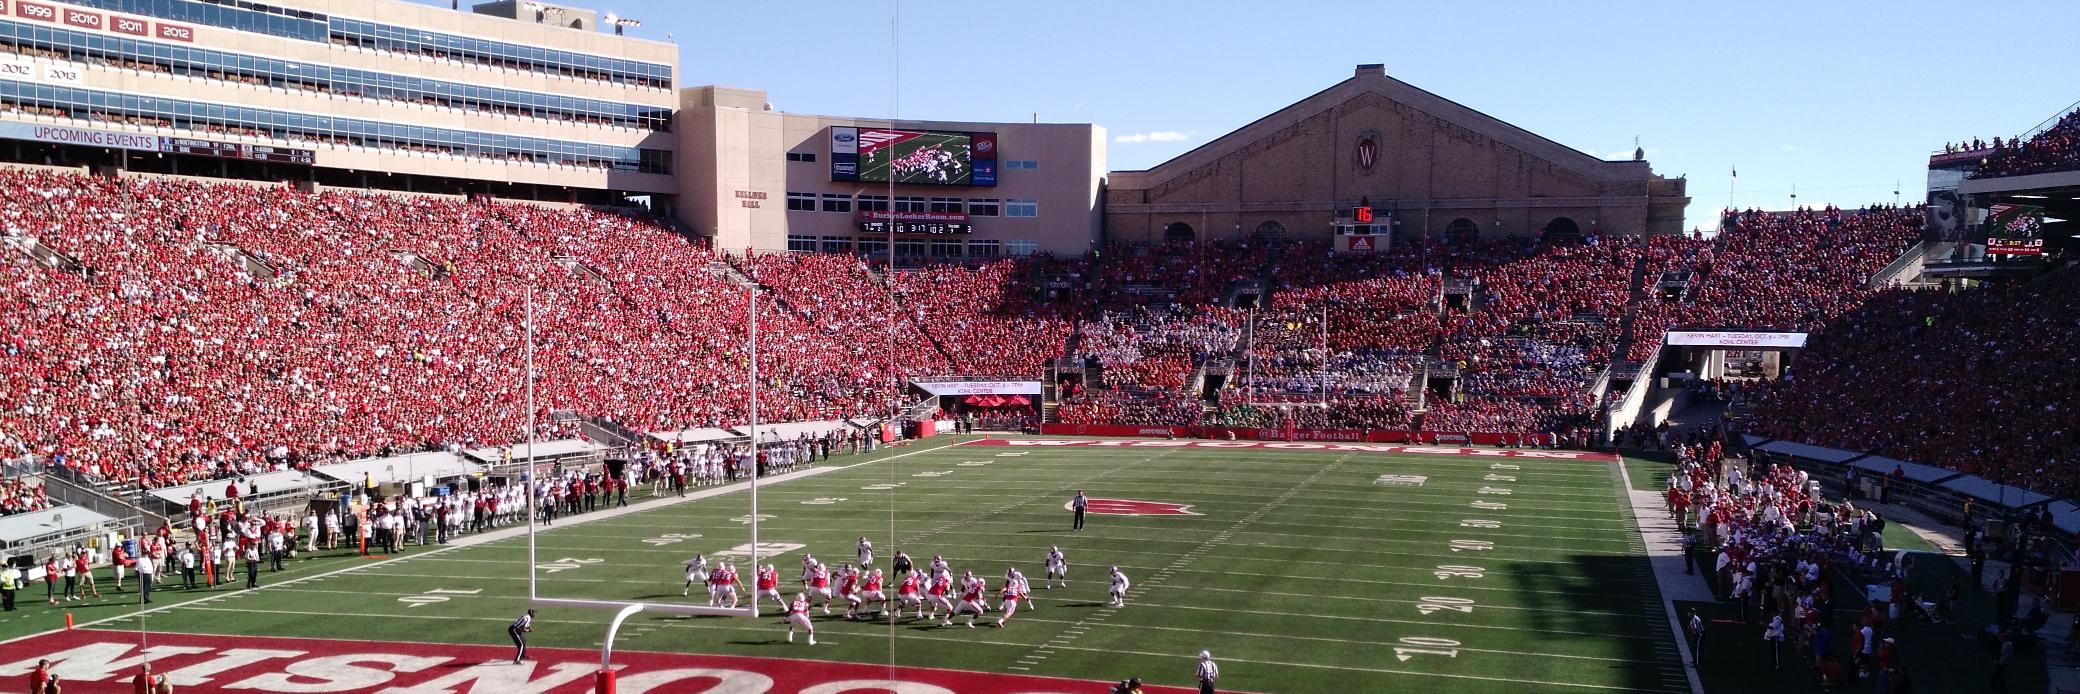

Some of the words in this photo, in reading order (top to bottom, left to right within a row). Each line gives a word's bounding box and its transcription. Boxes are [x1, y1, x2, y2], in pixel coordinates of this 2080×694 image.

[23, 5, 52, 18] 1999
[70, 12, 99, 25] 2010
[119, 20, 142, 32] 2011
[164, 27, 189, 38] 2012
[2, 64, 30, 75] 2012
[50, 70, 77, 80] 2013
[34, 126, 102, 144] UPCOMING
[106, 133, 152, 148] EVENTS
[1360, 146, 1375, 166] W
[1358, 208, 1371, 222] 16
